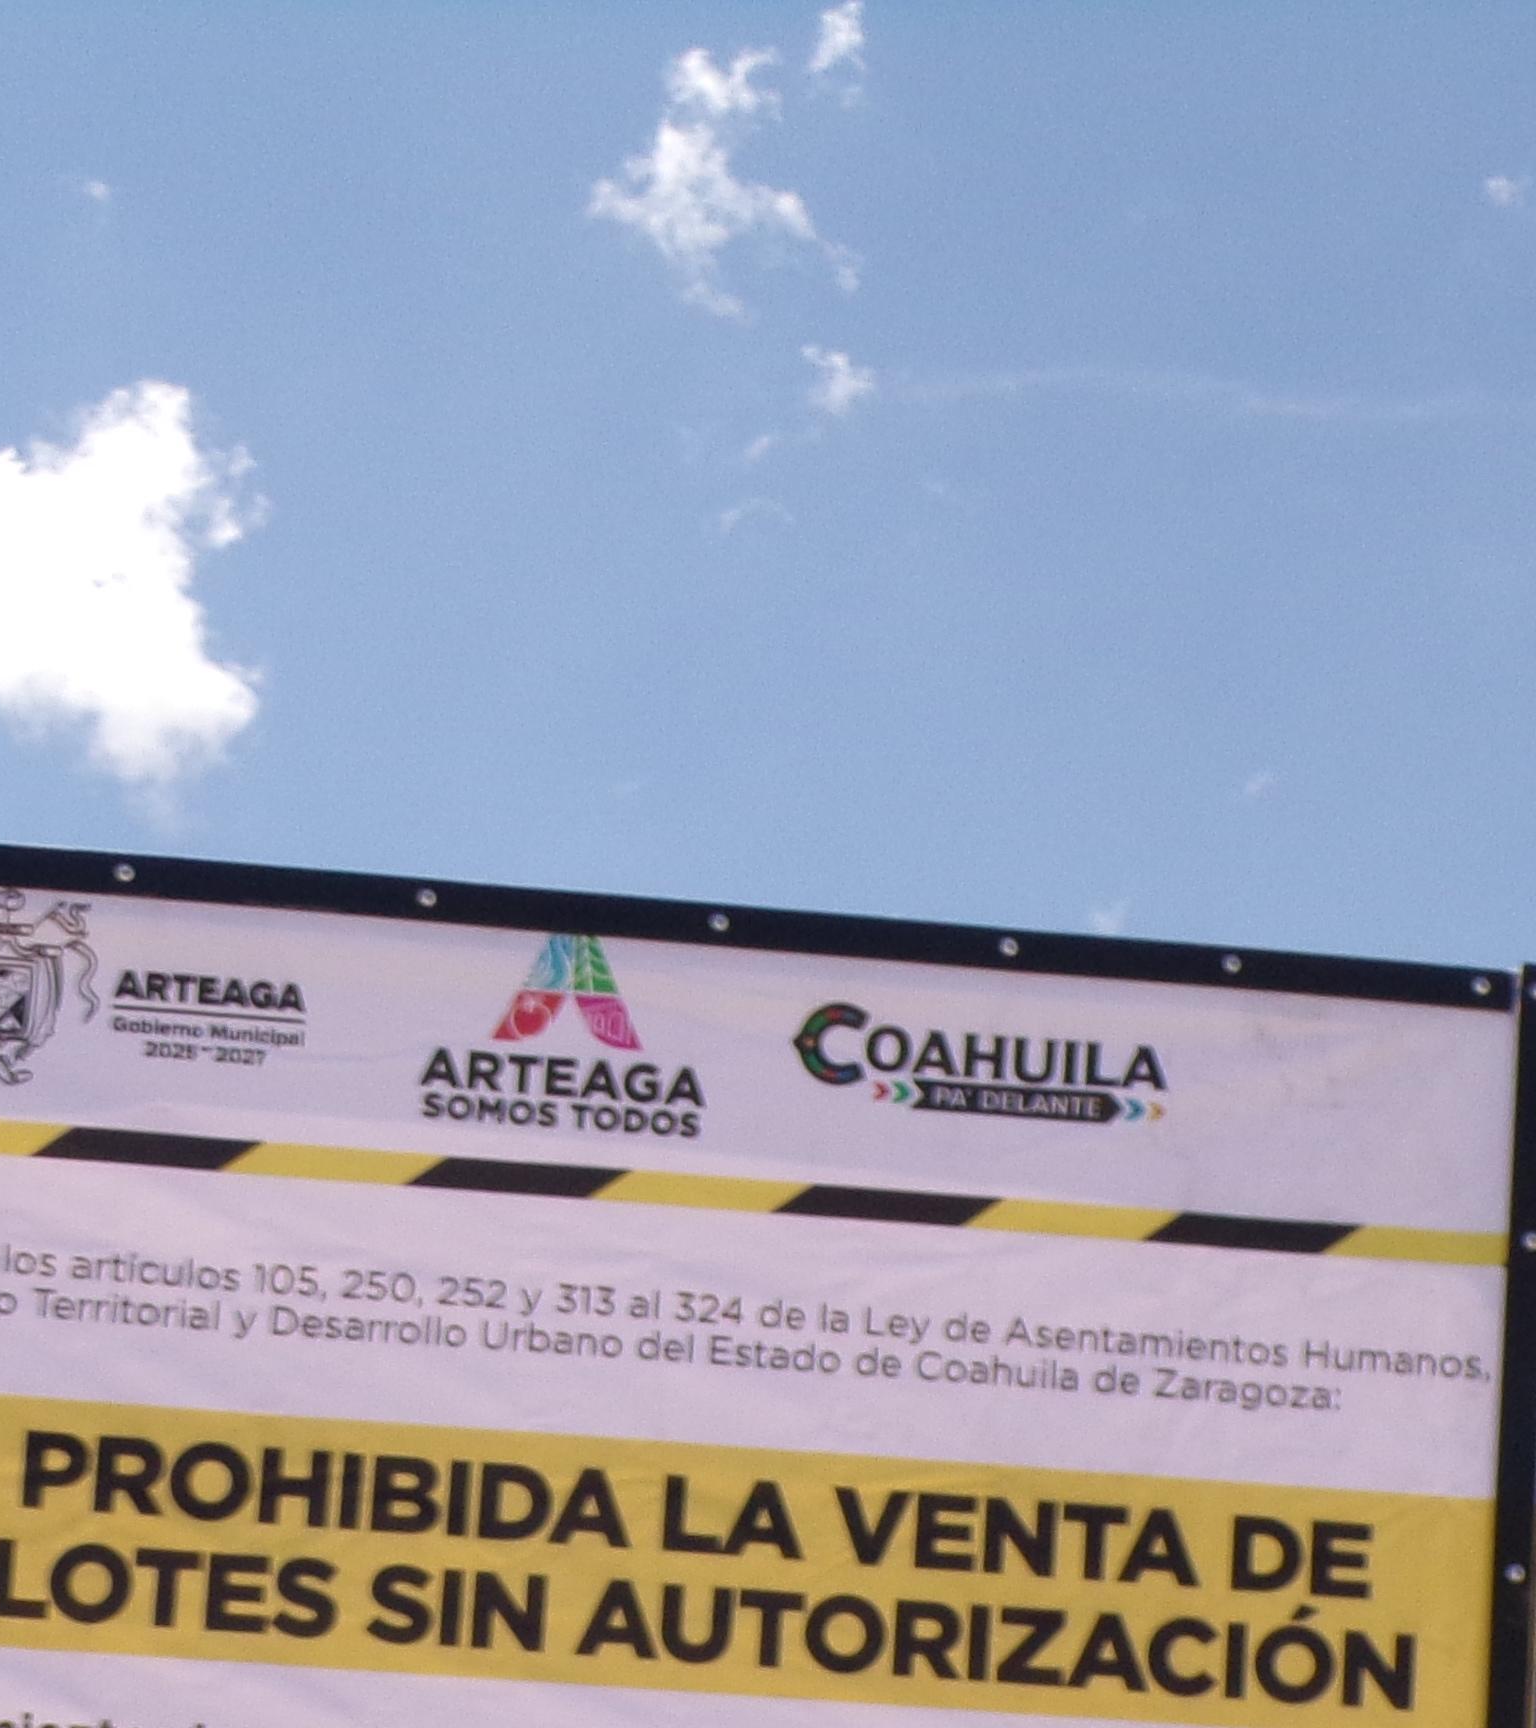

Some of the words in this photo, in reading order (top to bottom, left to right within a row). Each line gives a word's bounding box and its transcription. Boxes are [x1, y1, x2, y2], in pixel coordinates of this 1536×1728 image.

[114, 969, 306, 1012] ARTEAGA
[112, 1016, 204, 1038] Gobierno
[209, 1023, 306, 1047] Municipal
[793, 1003, 1168, 1091] COAHUILA
[420, 1047, 706, 1108] ARTEAGA
[982, 1090, 1103, 1118] DELANTE
[421, 1092, 559, 1128] SOMOS
[570, 1103, 700, 1139] TODOS
[28, 1286, 222, 1333] Territorial
[231, 1309, 260, 1341] y
[267, 1302, 469, 1350] Desarrollo
[478, 1318, 625, 1360] Urbano
[633, 1329, 696, 1365] del
[705, 1333, 843, 1377] Estado
[850, 1345, 904, 1381] de
[911, 1349, 1080, 1394] Coahuila
[1090, 1362, 1142, 1398] de
[66, 1250, 242, 1294] artículos
[251, 1261, 328, 1305] 105,
[337, 1267, 425, 1310] 250,
[434, 1274, 509, 1311] 252
[516, 1286, 544, 1319] y
[553, 1281, 618, 1318] 313
[625, 1289, 662, 1322] al
[672, 1289, 745, 1327] 324
[756, 1296, 807, 1332] de
[816, 1301, 851, 1336] la
[860, 1305, 933, 1347] Ley
[940, 1311, 993, 1346] de
[1000, 1315, 1289, 1370] Asentamientos
[1300, 1338, 1491, 1381] Humanos,
[20, 1428, 633, 1550] PROHIBIDA
[660, 1473, 805, 1562] LA
[833, 1485, 1201, 1589] VENTA
[1229, 1513, 1375, 1601] DE
[365, 1562, 550, 1654] SIN
[572, 1577, 1418, 1712] AUTORIZACIÓN
